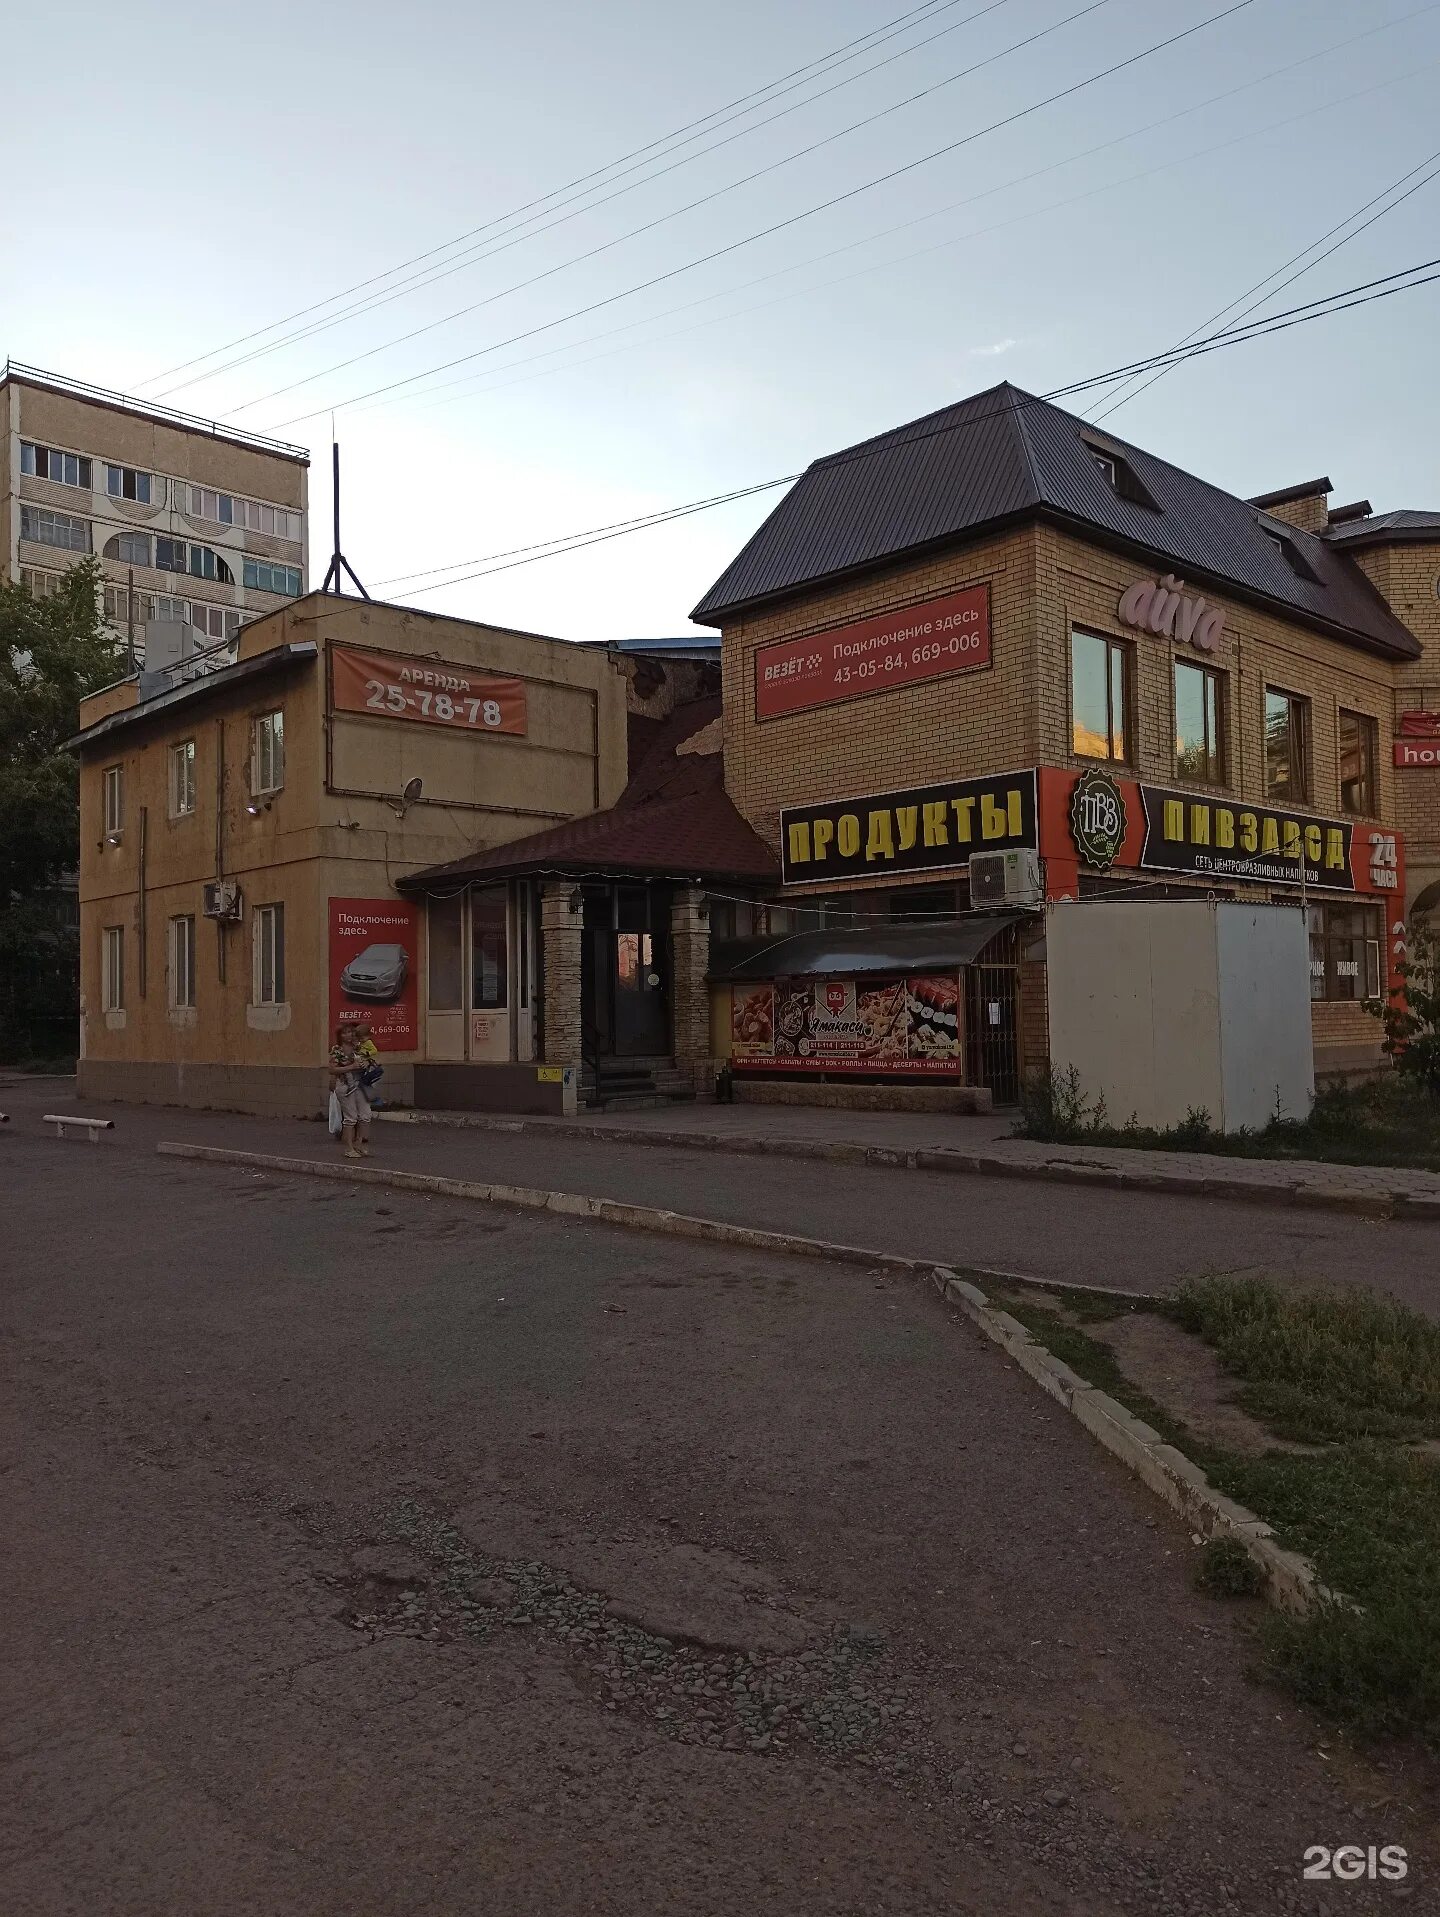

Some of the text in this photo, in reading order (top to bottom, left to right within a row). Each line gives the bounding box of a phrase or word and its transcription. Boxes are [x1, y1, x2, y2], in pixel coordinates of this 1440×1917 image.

[833, 608, 979, 659] Подключение здесь
[765, 656, 805, 681] ВЕЗЁТ
[833, 652, 909, 684] 43-05-84,
[911, 631, 980, 664] 669-006
[398, 667, 471, 692] АРЕНДА
[365, 680, 501, 726] 25-78-78
[788, 790, 1023, 863] ПРОДУКТЫ
[1163, 800, 1345, 870] ПИВЗАВОД
[1369, 833, 1397, 867] 24
[1195, 855, 1213, 869] СЕТЬ
[1370, 869, 1398, 888] ЧАСА
[338, 913, 409, 925] Подключение
[338, 927, 368, 936] здесь
[1337, 961, 1358, 976] ЖИВОЕ
[340, 1010, 362, 1019] ВЕЗЁТ
[810, 1017, 864, 1034] Ямакаси
[892, 1061, 922, 1069] ДЕСЕРТЫ
